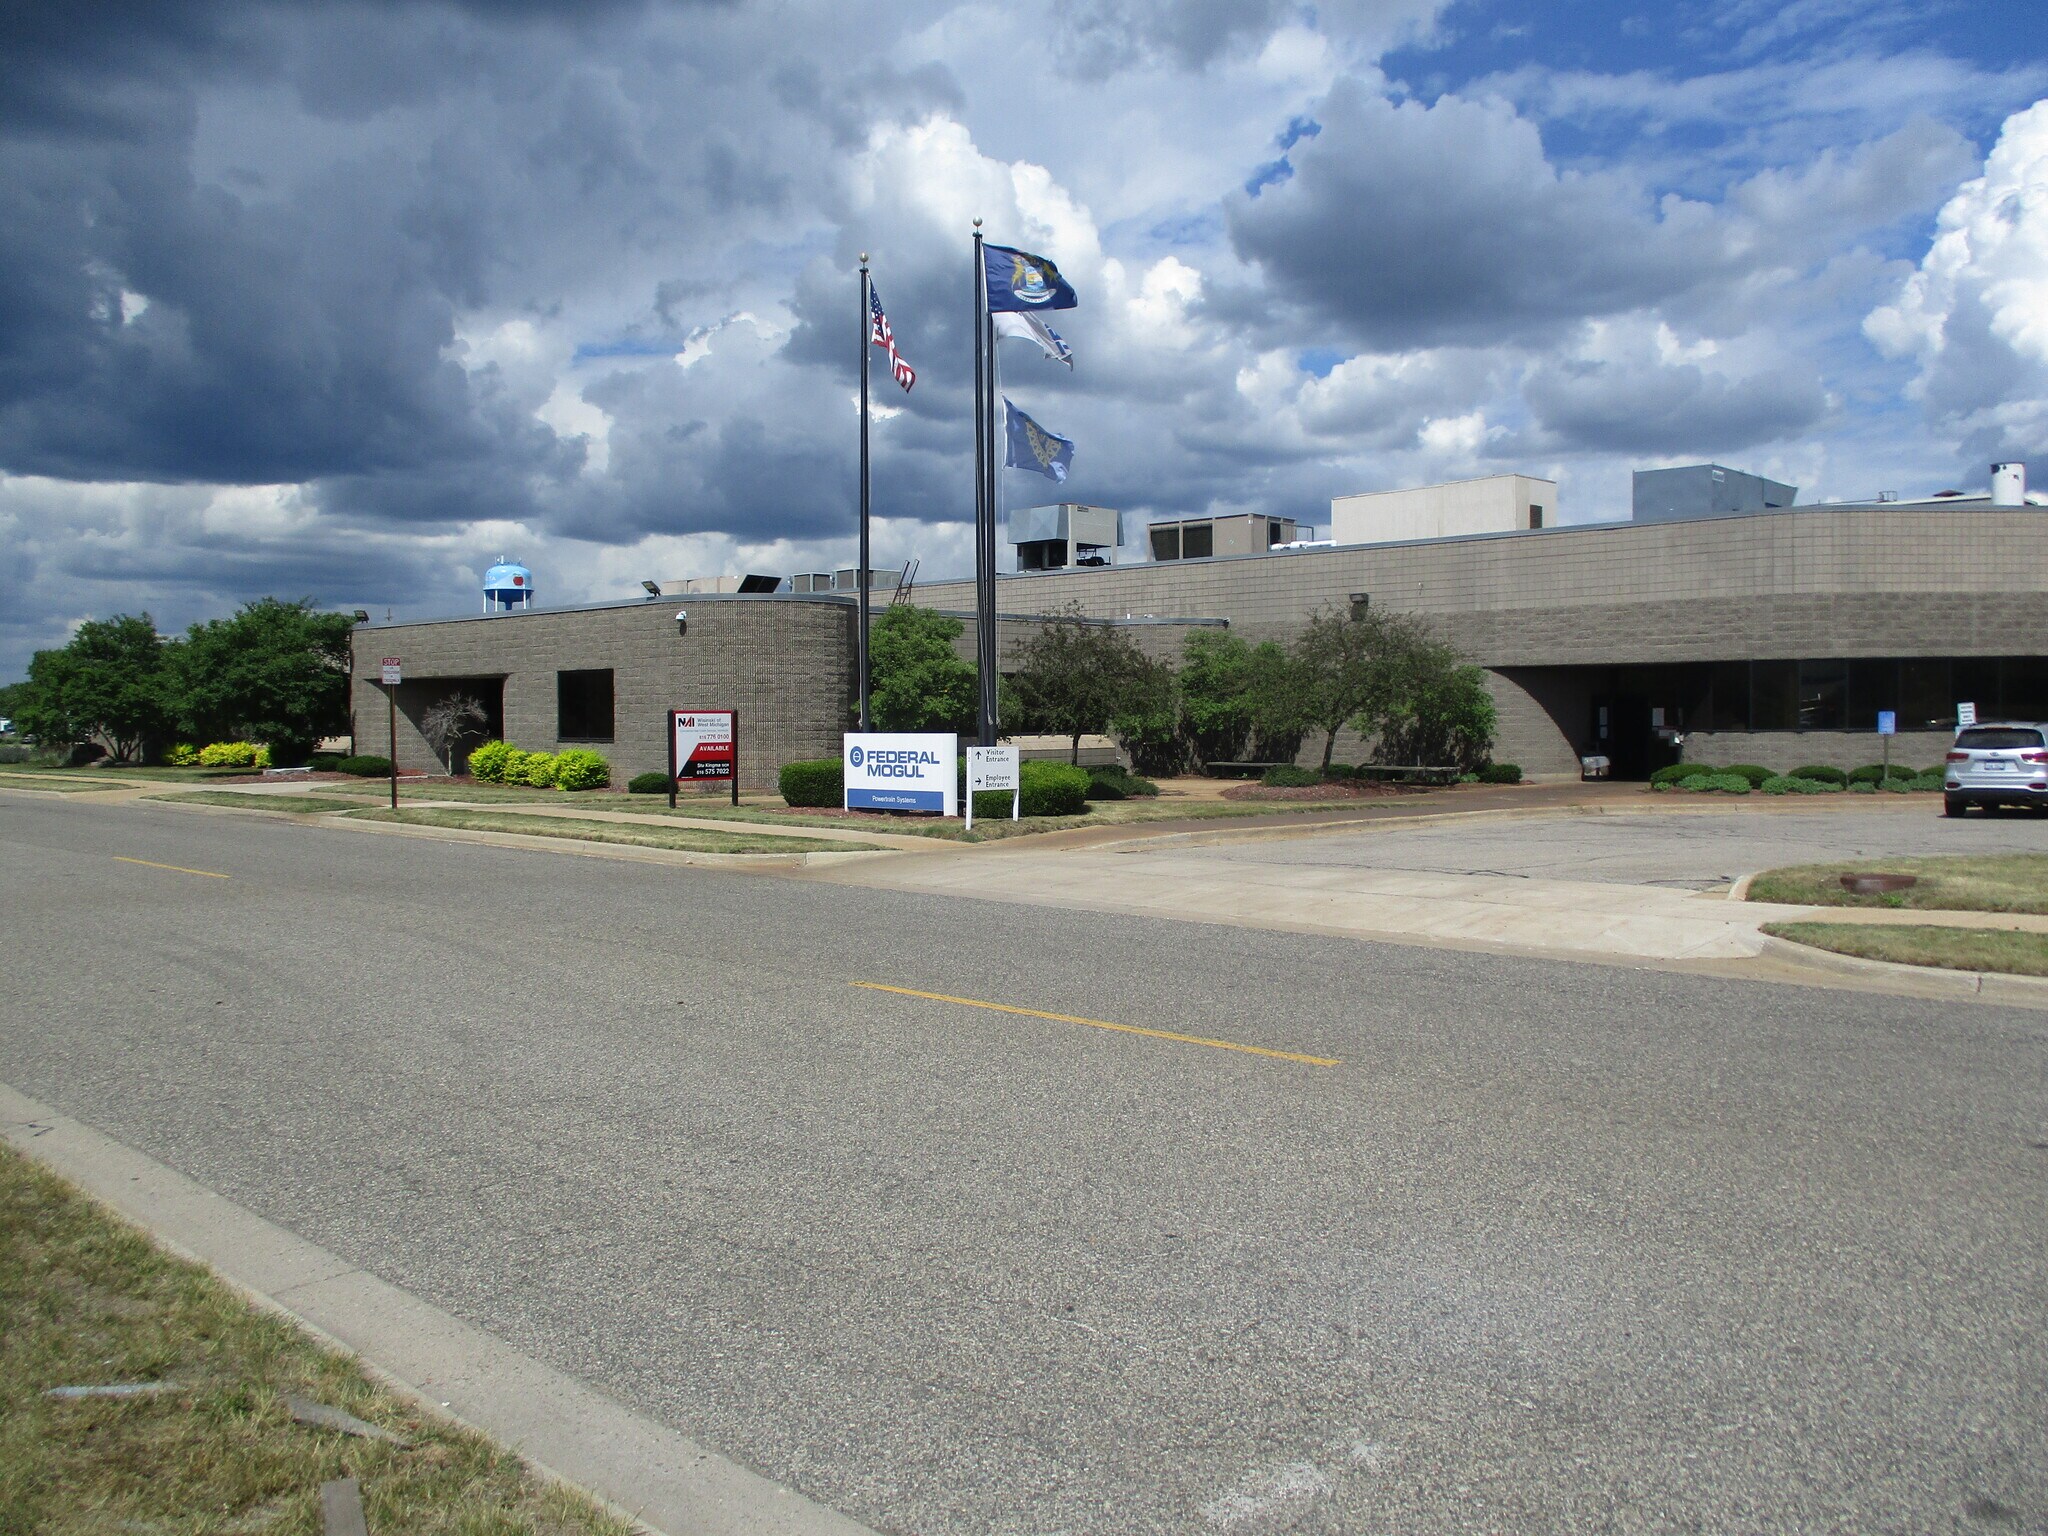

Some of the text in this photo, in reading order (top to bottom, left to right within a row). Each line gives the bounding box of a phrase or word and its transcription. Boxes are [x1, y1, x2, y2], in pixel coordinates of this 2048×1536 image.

[383, 658, 400, 666] STOP
[678, 716, 695, 727] NAI
[867, 751, 940, 764] FEDERAL
[867, 764, 925, 778] MOGUL
[986, 774, 1011, 782] Employee
[872, 795, 917, 805] Powertrain Systems
